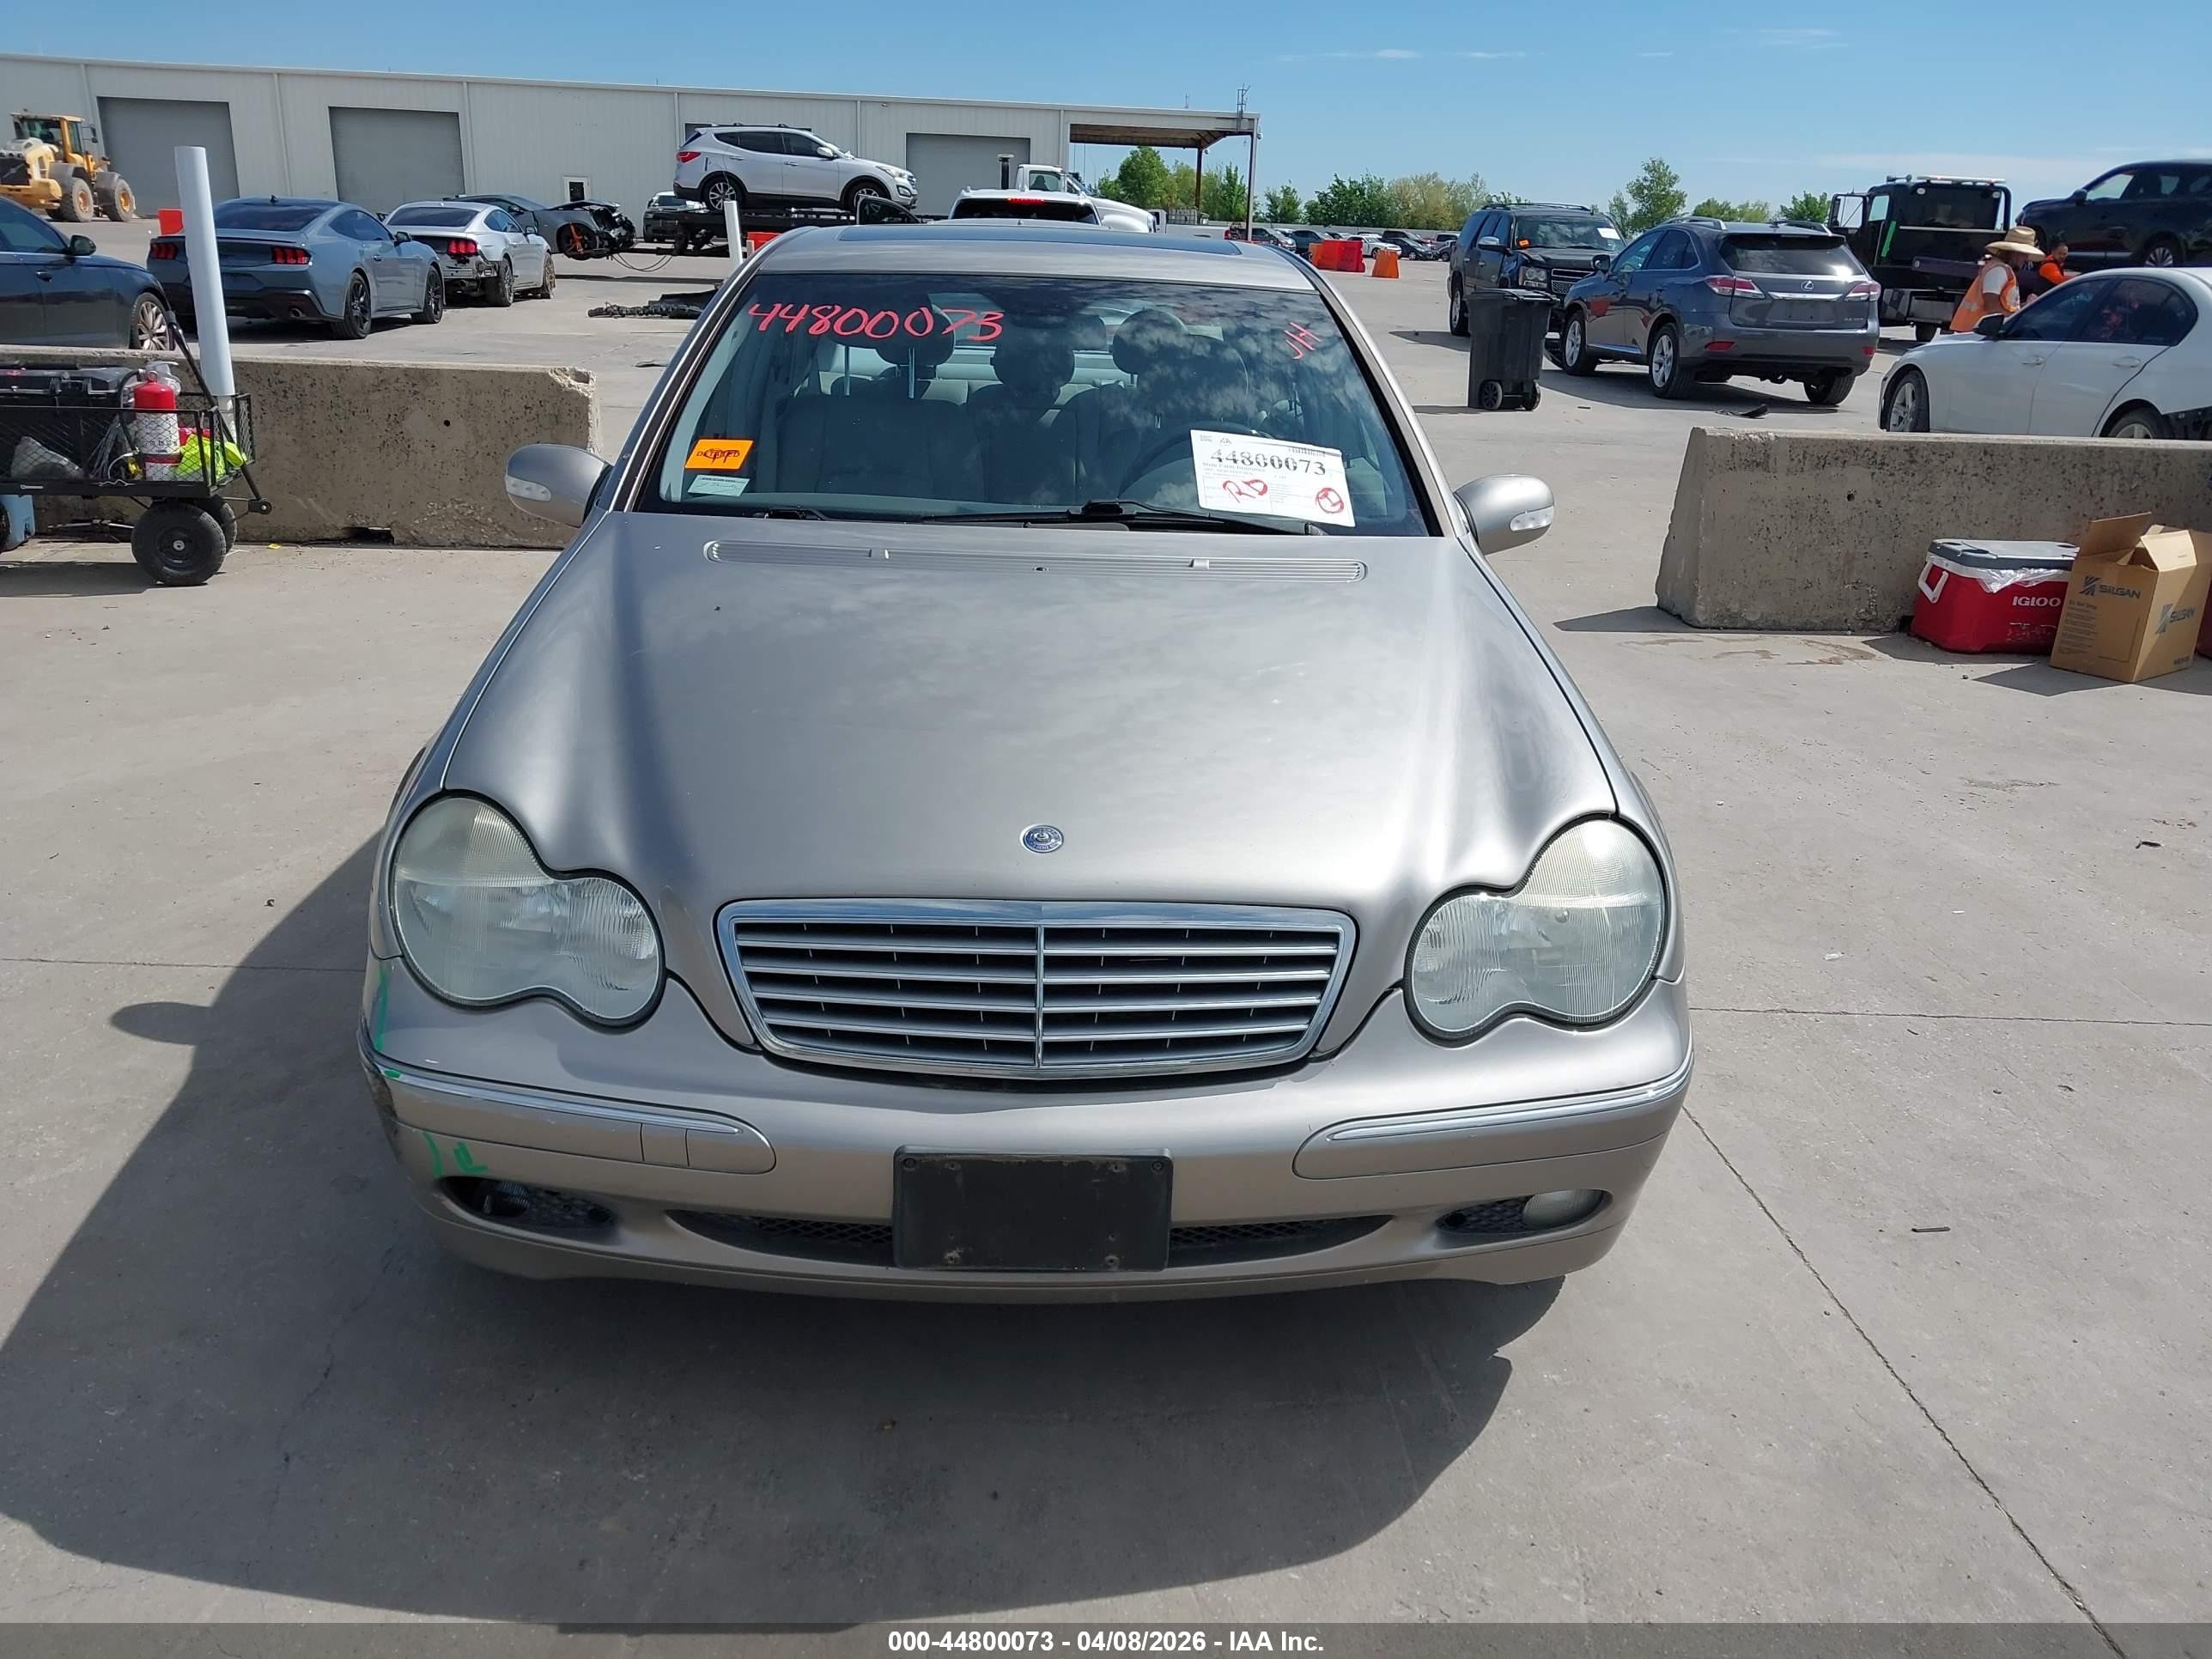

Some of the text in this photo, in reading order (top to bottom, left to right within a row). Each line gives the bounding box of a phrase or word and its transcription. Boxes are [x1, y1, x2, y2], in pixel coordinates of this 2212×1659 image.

[748, 303, 1005, 342] 44800073
[1210, 448, 1326, 476] 44800073
[2012, 596, 2062, 607] IGLOO
[2098, 584, 2141, 599] SILGAN
